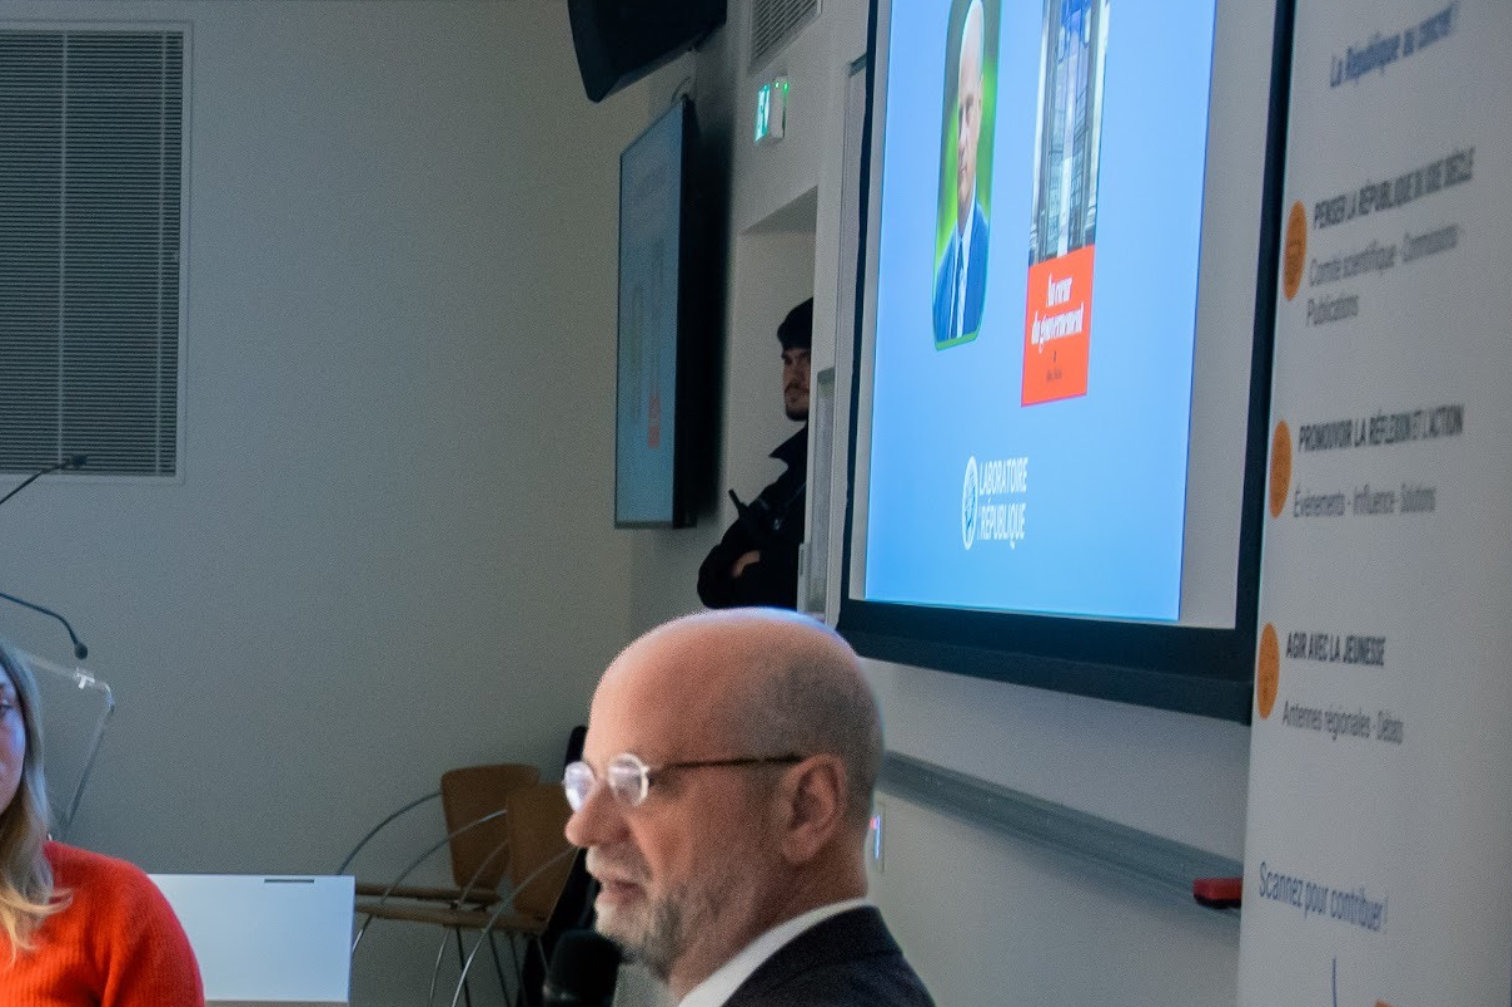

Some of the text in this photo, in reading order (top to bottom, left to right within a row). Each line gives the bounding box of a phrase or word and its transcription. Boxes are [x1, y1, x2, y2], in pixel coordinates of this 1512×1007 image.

[1313, 195, 1347, 230] PENSER
[1347, 191, 1357, 221] LA
[1358, 179, 1414, 216] RÉPUBLIQUE
[1342, 239, 1397, 278] scientifique
[1299, 419, 1352, 452] PROMOUVOIR
[1354, 418, 1367, 448] LA
[1368, 409, 1411, 446] RÉFLEXION
[979, 457, 1028, 496] LABORATOIRE
[981, 497, 1027, 550] RÉPUBLIQUE
[1286, 630, 1386, 667] AGIR AVEC LA JEUNESSE
[1282, 700, 1323, 732] Antennes
[1324, 703, 1371, 742] régionales
[1259, 861, 1303, 908] Scannez
[1305, 881, 1329, 921] pour
